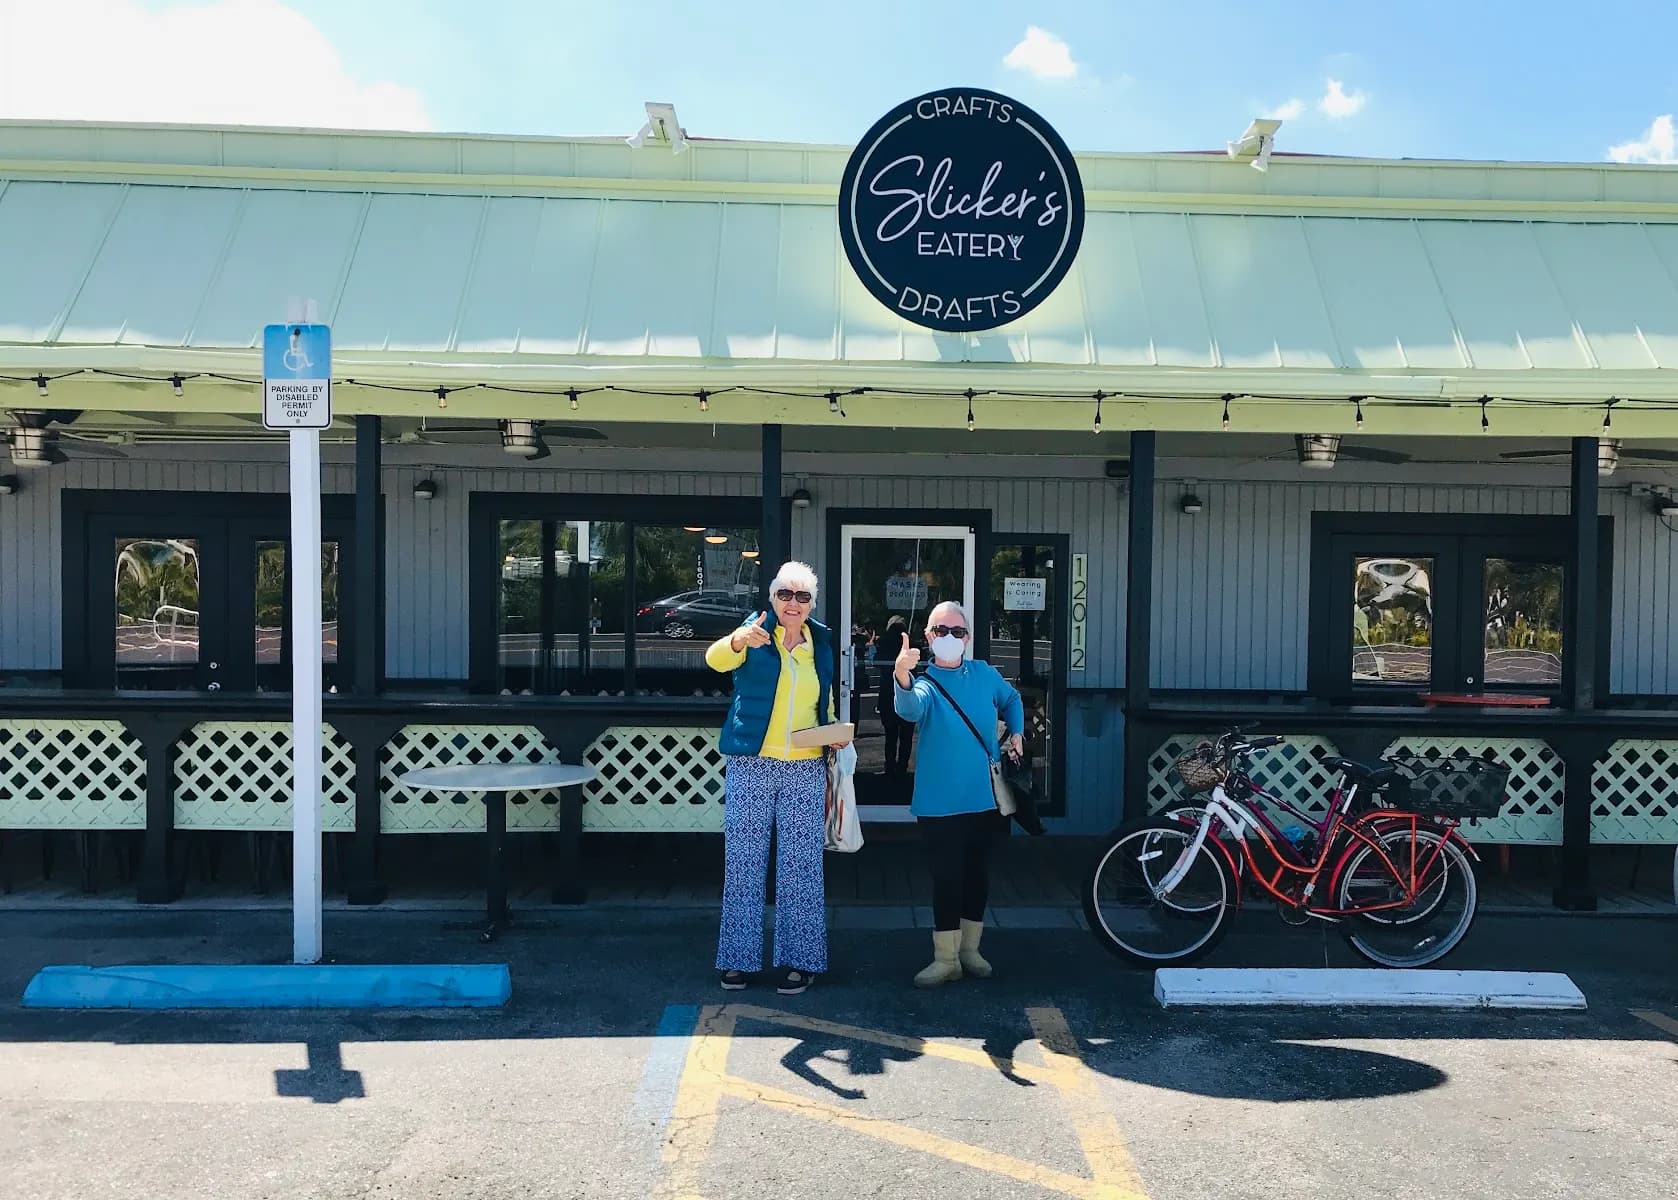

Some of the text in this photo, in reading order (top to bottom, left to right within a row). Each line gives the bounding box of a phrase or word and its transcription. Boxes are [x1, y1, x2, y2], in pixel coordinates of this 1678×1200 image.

[916, 96, 1014, 124] CRAFTS
[869, 155, 1063, 242] Slicker's
[917, 231, 1025, 260] EATERY
[898, 286, 1021, 321] DRAFTS
[1009, 581, 1041, 589] Wearing
[1015, 589, 1041, 597] Caring
[1072, 557, 1086, 668] 12012
